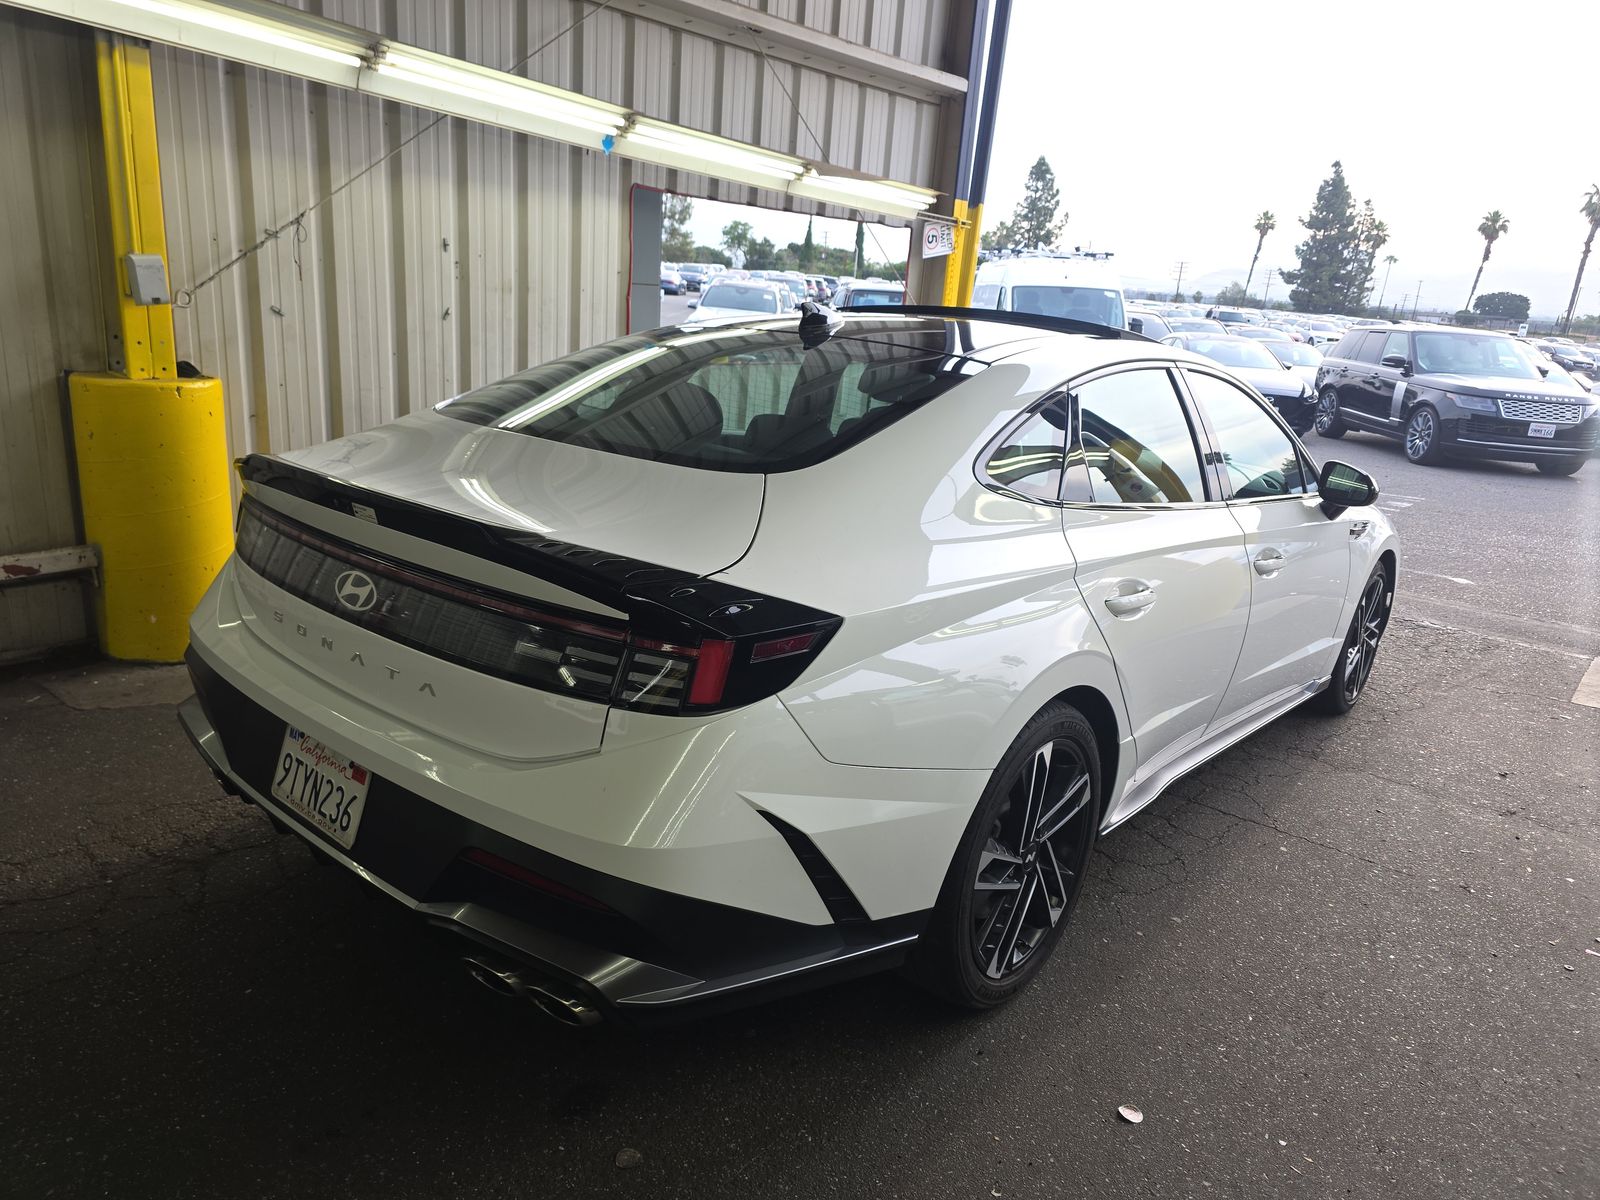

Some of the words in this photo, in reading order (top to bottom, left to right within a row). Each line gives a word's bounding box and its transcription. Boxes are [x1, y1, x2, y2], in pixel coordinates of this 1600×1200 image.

[927, 234, 938, 244] 5
[273, 610, 437, 697] SONATA
[300, 735, 351, 781] California
[277, 752, 358, 832] 9TYN236
